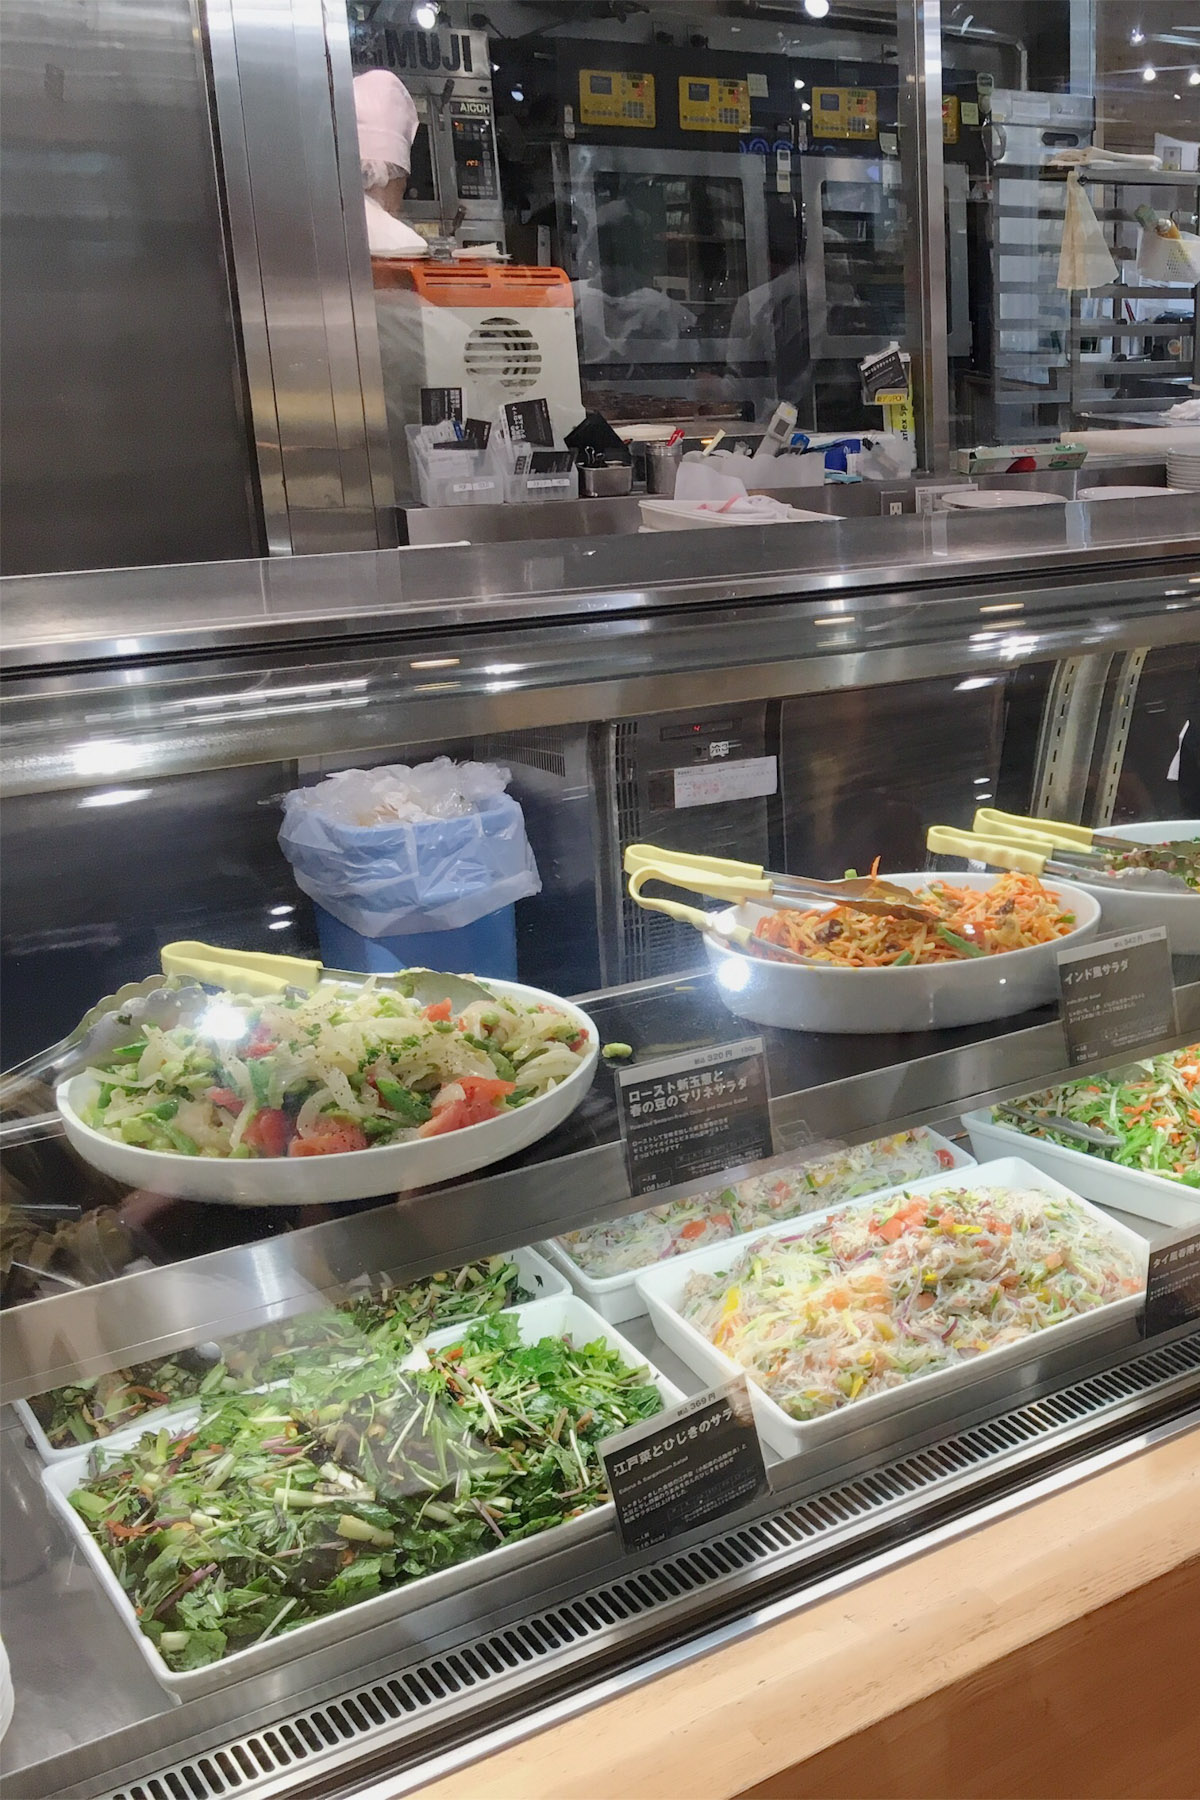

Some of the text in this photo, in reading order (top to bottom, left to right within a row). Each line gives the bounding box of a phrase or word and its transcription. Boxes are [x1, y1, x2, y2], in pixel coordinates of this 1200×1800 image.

[384, 28, 473, 73] MUJI
[1064, 959, 1128, 985] インド風サラダ
[630, 1077, 748, 1117] 春の豆のマリネサラダ
[690, 1397, 707, 1411] 369
[673, 1456, 689, 1468] Salad
